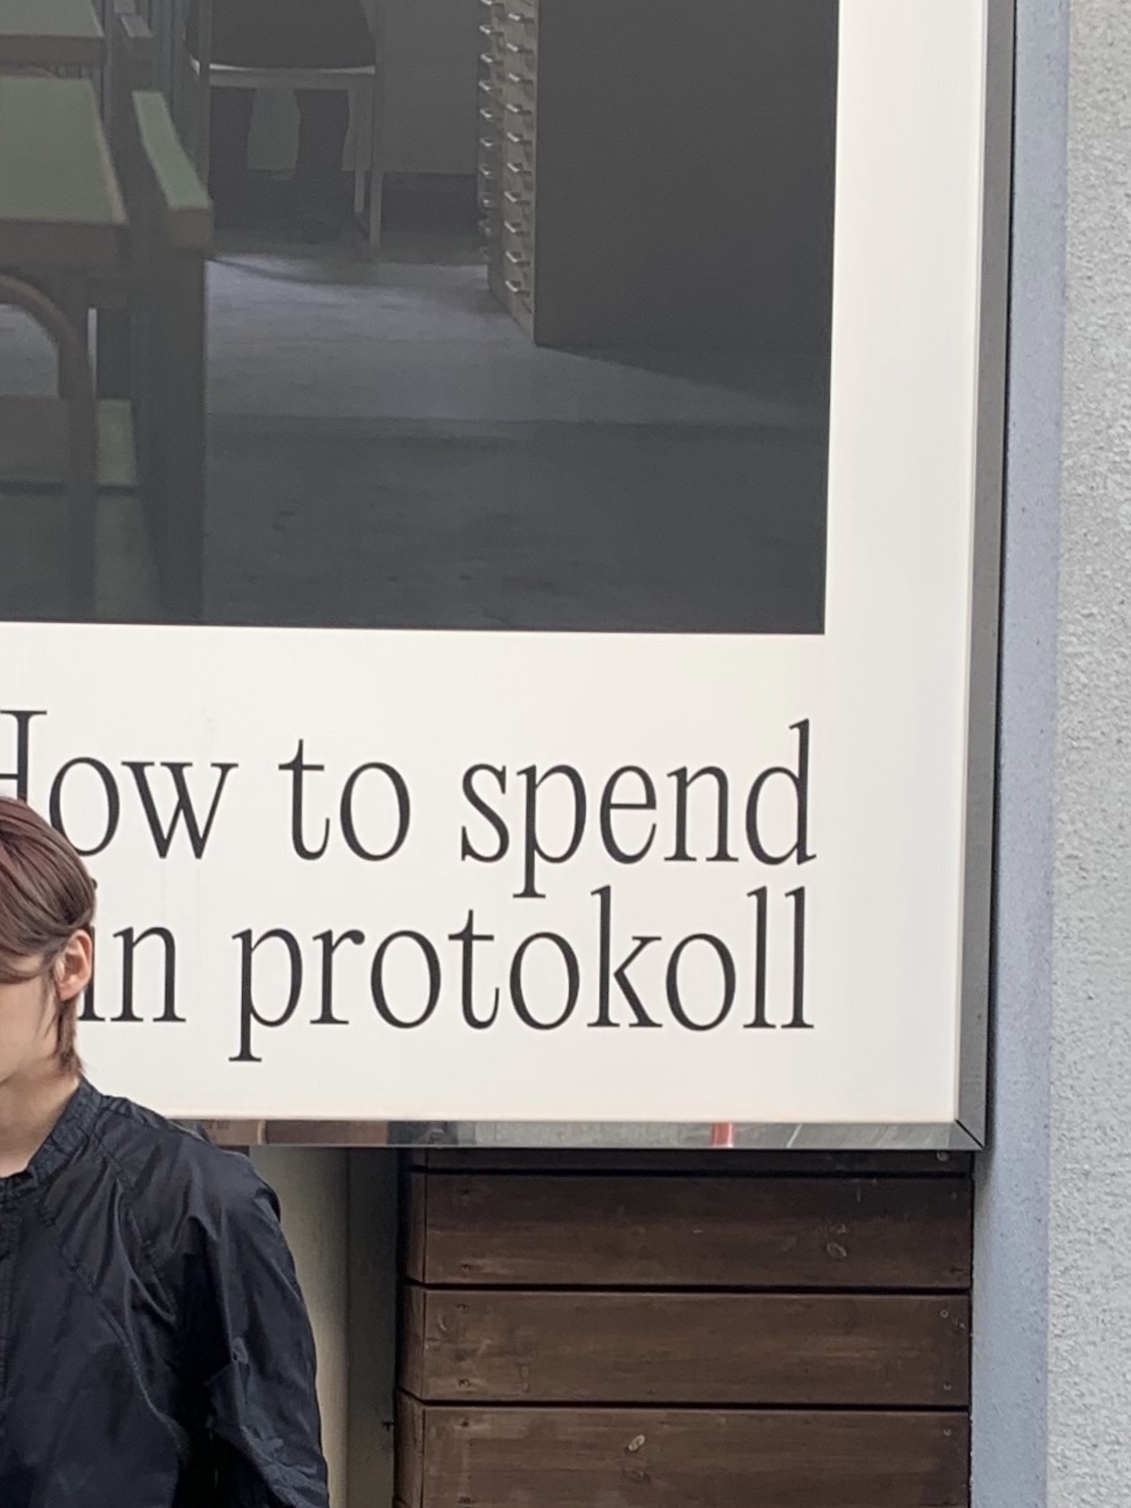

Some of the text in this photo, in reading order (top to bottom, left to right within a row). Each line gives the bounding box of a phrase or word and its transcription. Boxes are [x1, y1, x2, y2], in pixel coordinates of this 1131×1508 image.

[278, 739, 410, 862] to
[461, 718, 817, 899] spend
[228, 885, 814, 1062] protokoll
